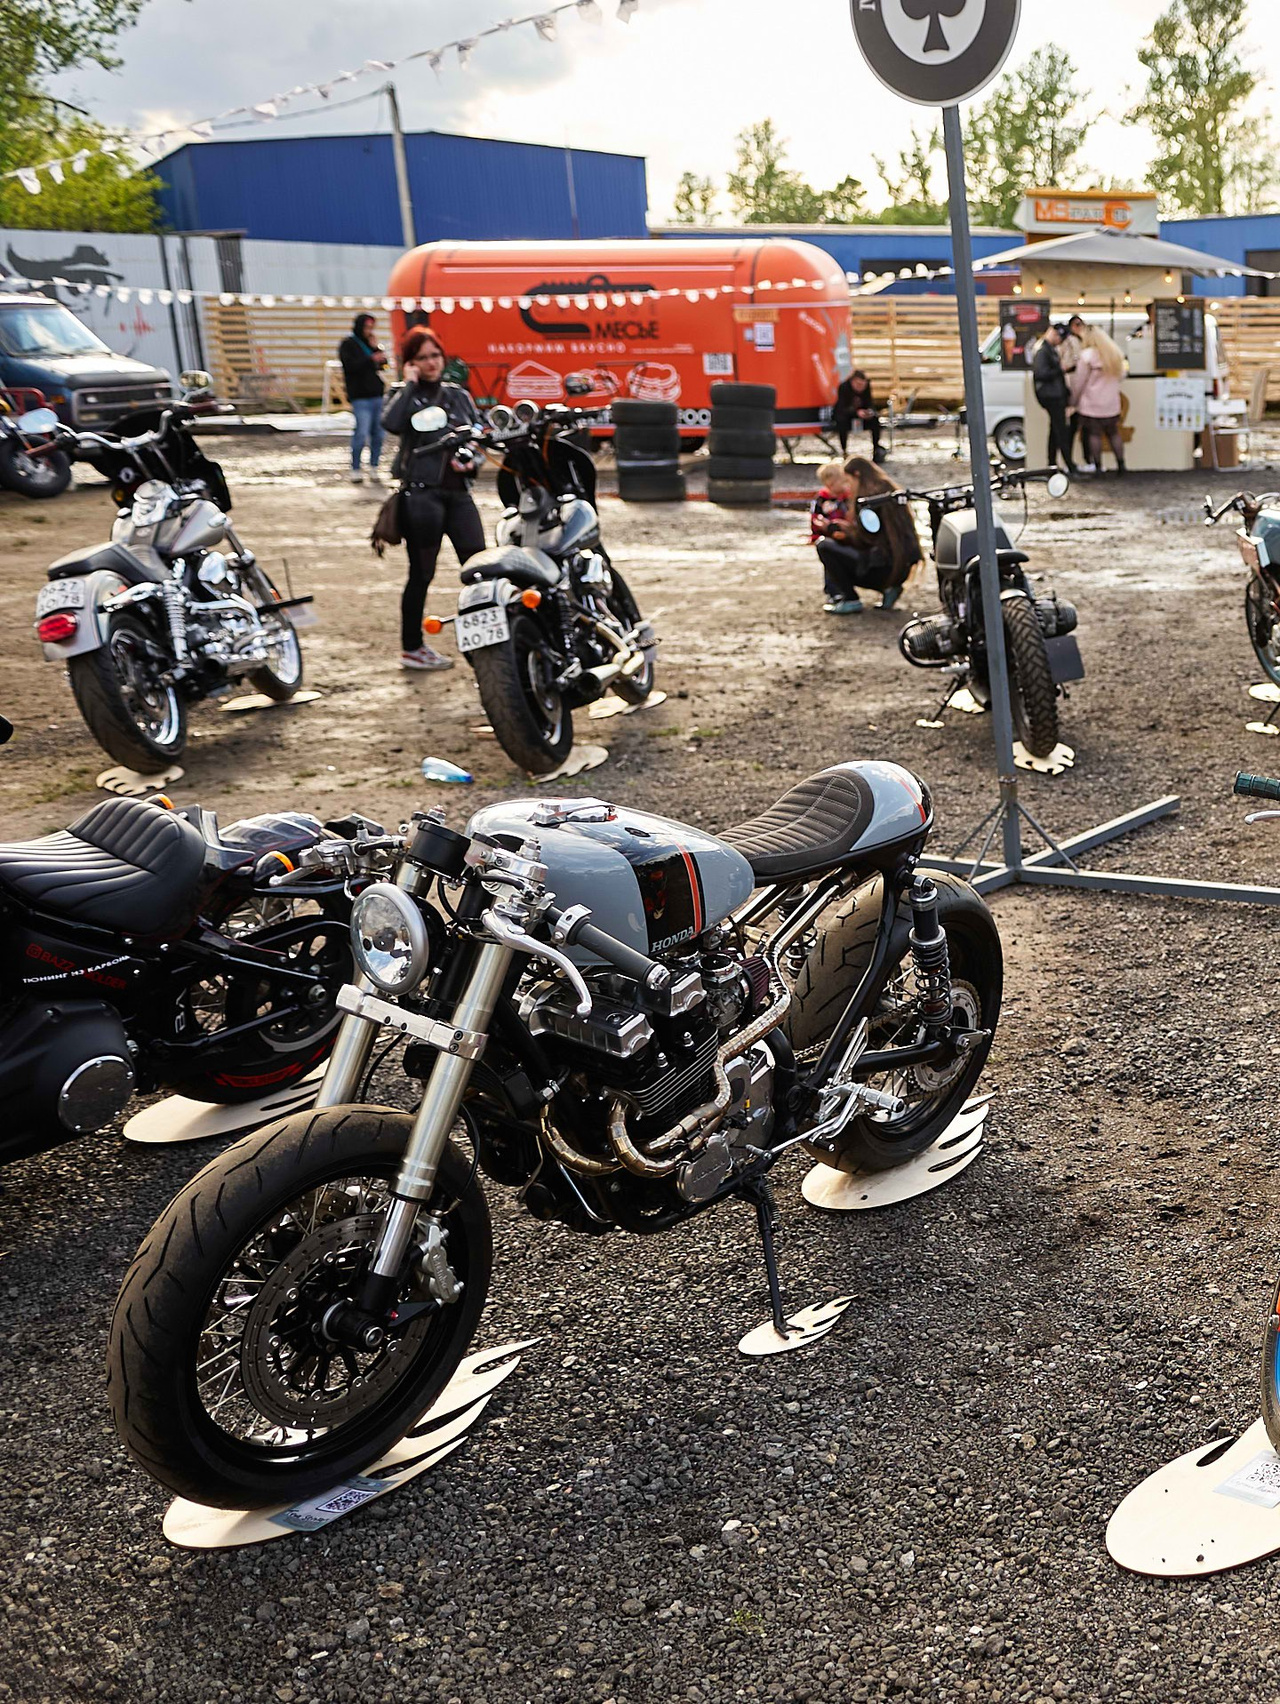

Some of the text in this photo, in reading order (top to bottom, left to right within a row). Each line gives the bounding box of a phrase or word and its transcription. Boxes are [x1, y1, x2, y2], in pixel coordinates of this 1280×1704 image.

[61, 595, 80, 604] 78
[462, 610, 498, 629] 6823
[487, 628, 504, 640] 78
[651, 926, 694, 953] HONDA
[22, 972, 69, 984] ТЮНИНГ
